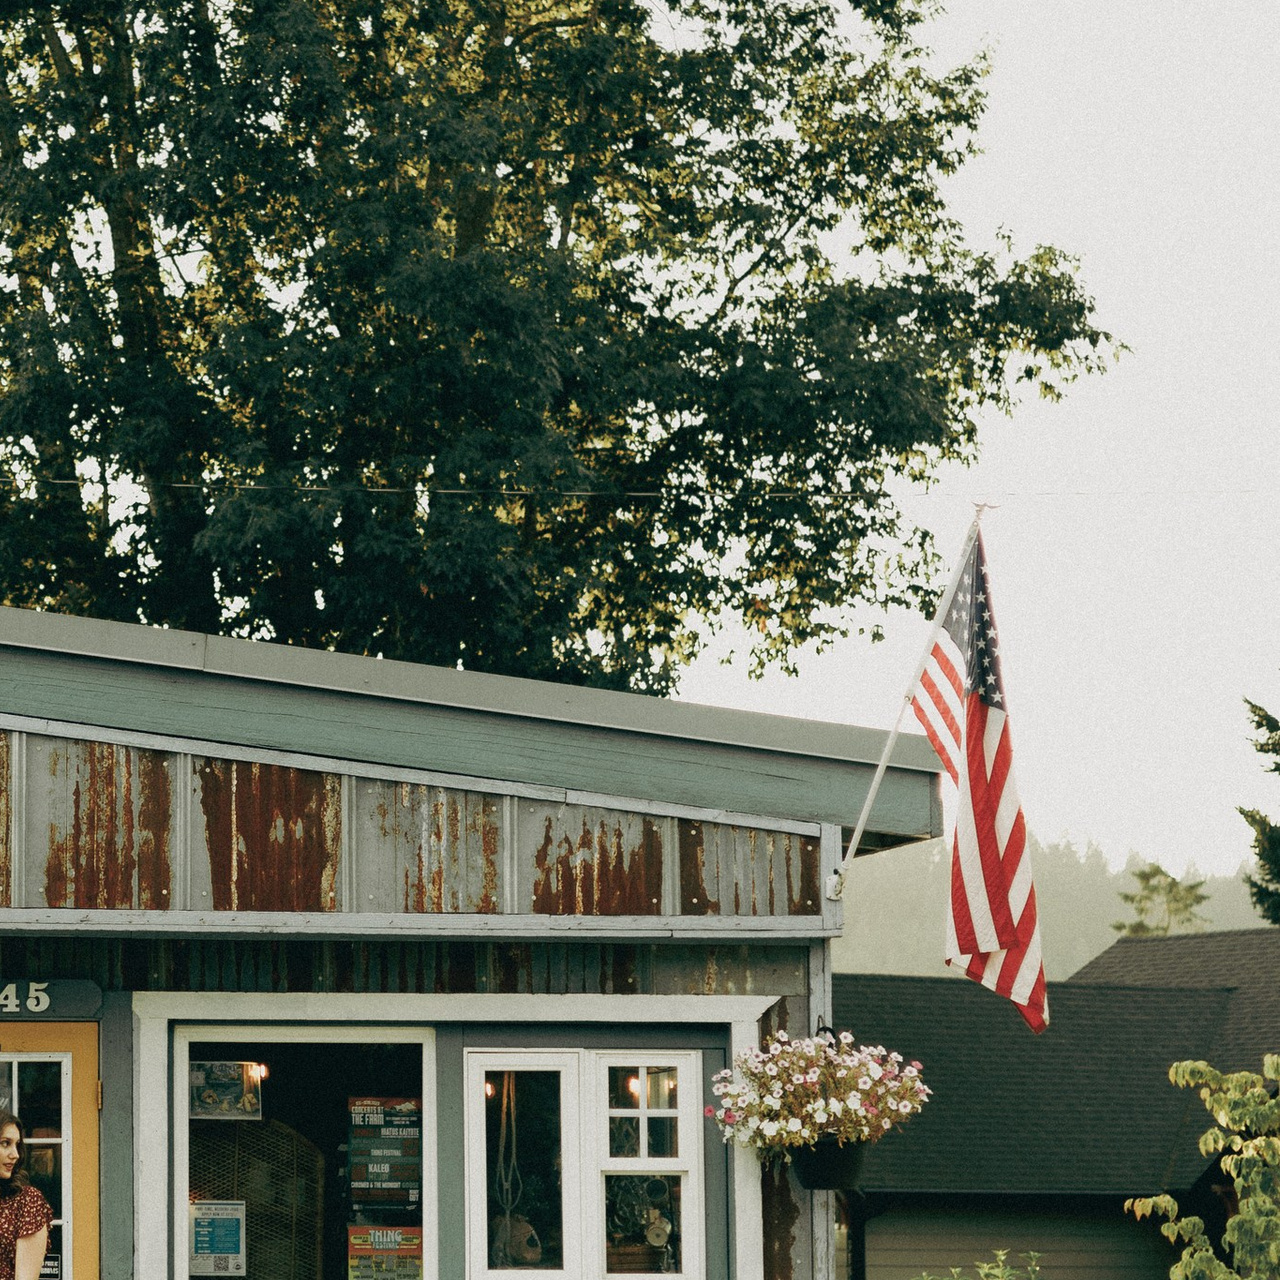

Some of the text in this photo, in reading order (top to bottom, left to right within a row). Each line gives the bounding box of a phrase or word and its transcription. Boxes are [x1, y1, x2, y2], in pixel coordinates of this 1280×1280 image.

[352, 1113, 364, 1125] THE
[365, 1113, 384, 1125] FARM
[368, 1163, 390, 1173] KALEO
[369, 1230, 402, 1242] THING
[372, 1241, 399, 1249] FESTIVAL
